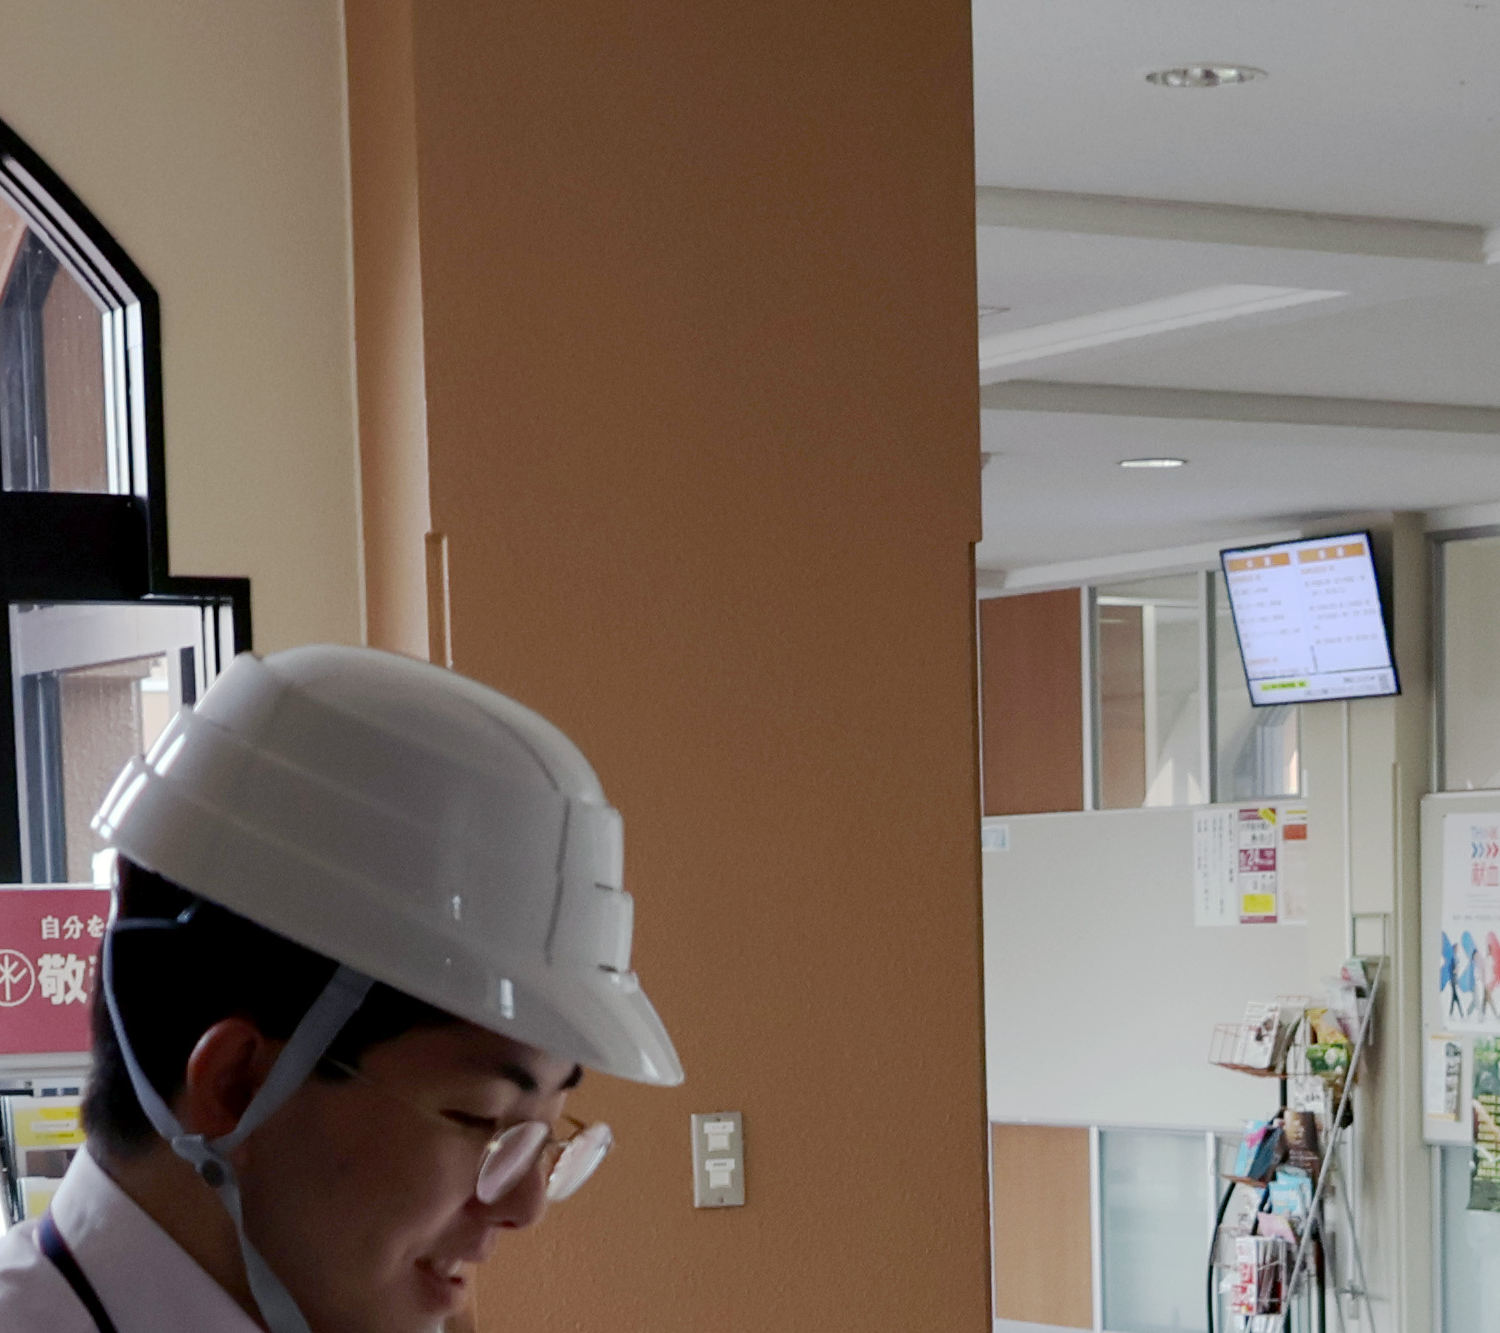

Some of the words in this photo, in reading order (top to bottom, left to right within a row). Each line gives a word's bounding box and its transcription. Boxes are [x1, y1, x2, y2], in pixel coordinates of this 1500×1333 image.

[41, 915, 105, 939] 自分を
[37, 953, 98, 1005] 敬
